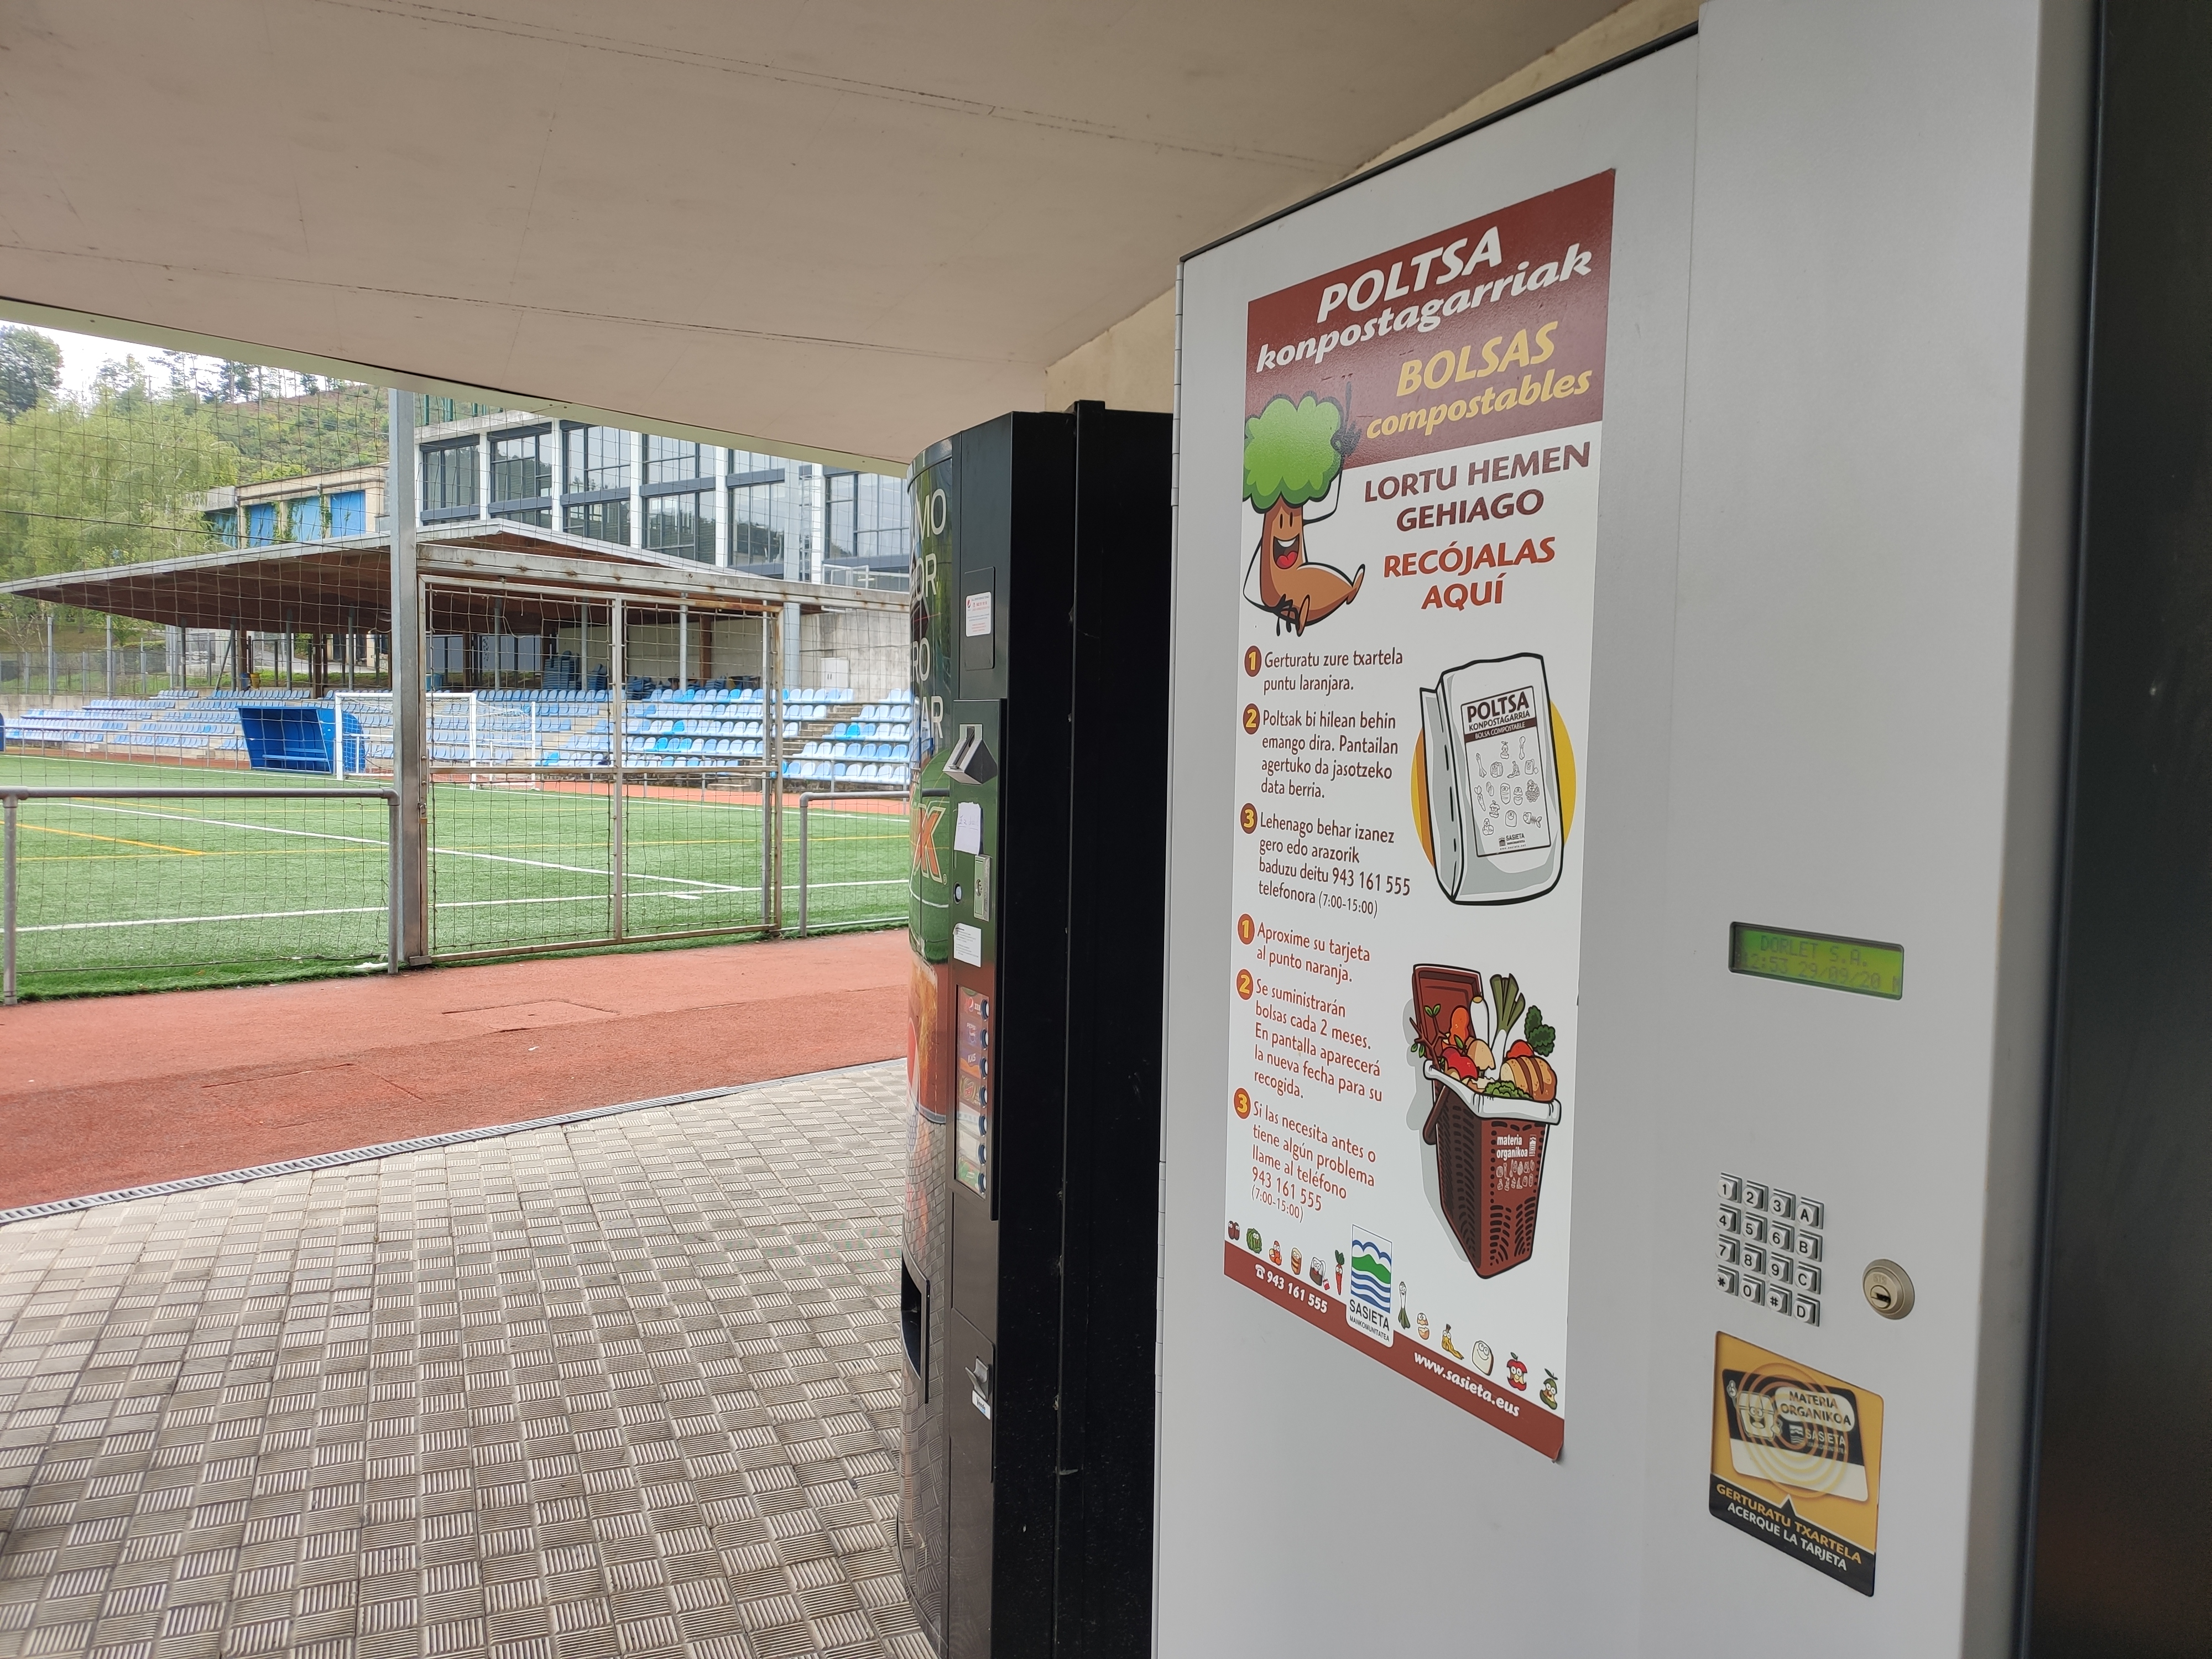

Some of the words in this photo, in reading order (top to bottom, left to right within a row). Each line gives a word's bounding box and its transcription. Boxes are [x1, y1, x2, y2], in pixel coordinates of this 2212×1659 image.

[1317, 226, 1502, 323] POLTSA
[1256, 243, 1592, 373] konpostagarriak
[1396, 321, 1558, 396] BOLSAS
[1366, 370, 1592, 439] compostables
[1364, 465, 1457, 503] LORTU
[1468, 441, 1590, 486] HEMEN
[1396, 489, 1544, 531] GEHIAGO
[1383, 536, 1555, 577] RECÓJALAS
[1421, 573, 1503, 611] AQUÍ
[1248, 651, 1256, 671] 1
[1265, 651, 1319, 668] Gerturatu
[1323, 655, 1349, 667] zure
[1353, 647, 1404, 666] txartela
[1264, 676, 1296, 696] puntu
[1300, 674, 1354, 696] laranjara.
[1245, 708, 1257, 728] 2
[1263, 709, 1302, 726] Poltsak
[1306, 711, 1316, 727] bi
[1319, 711, 1355, 728] hilean
[1360, 711, 1396, 729] behin
[1467, 691, 1529, 723] POLTSA
[1469, 710, 1530, 731] KONPOSTAGARRIA
[1262, 737, 1305, 755] emango
[1309, 734, 1334, 752] dira.
[1339, 735, 1398, 754] Pantailan
[1475, 728, 1490, 739] BOLSA
[1490, 722, 1526, 735] COMPOSTABLE
[1261, 757, 1311, 776] agertuko
[1314, 758, 1328, 774] da
[1331, 759, 1392, 781] jasotzeko
[1261, 777, 1285, 795] data
[1288, 779, 1325, 798] berria.
[1244, 809, 1255, 828] 3
[1260, 812, 1313, 838] Lehenago
[1317, 818, 1351, 838] behar
[1355, 823, 1395, 843] izanez
[1506, 833, 1525, 841] SASIETA
[1260, 839, 1283, 855] gero
[1287, 838, 1308, 856] edo
[1311, 846, 1360, 863] arazorik
[1259, 857, 1297, 877] baduzu
[1300, 863, 1328, 883] deitu
[1332, 867, 1354, 886] 943
[1359, 871, 1381, 891] 161
[1386, 875, 1410, 896] 555
[1259, 880, 1316, 904] telefonora
[1318, 891, 1378, 919] (7:00-15:00)
[1241, 920, 1249, 938] 1
[1257, 922, 1310, 948] Aproxime
[1313, 939, 1326, 951] su
[1329, 939, 1370, 963] tarjeta
[1761, 935, 1818, 959] DORLET
[1829, 946, 1867, 967] S.A.
[1256, 945, 1265, 960] al
[1269, 952, 1302, 969] punto
[1306, 959, 1352, 984] naranja.
[1239, 974, 1250, 994] 2
[1256, 978, 1268, 995] Se
[1271, 988, 1345, 1018] suministrarán
[1256, 1000, 1287, 1023] bolsas
[1290, 1015, 1316, 1032] cada
[1320, 1019, 1328, 1036] 2
[1332, 1028, 1371, 1050] meses.
[967, 1053, 976, 1063] KAS
[1255, 1022, 1269, 1040] En
[1272, 1032, 1316, 1056] pantalla
[1320, 1047, 1380, 1077] aparecerá
[1254, 1071, 1303, 1099] recogida.
[1255, 1044, 1264, 1061] la
[1267, 1053, 1299, 1073] nueva
[1303, 1061, 1334, 1085] fecha
[1338, 1078, 1365, 1095] para
[1369, 1088, 1382, 1102] su
[1237, 1094, 1248, 1113] 3
[1254, 1101, 1262, 1118] Si
[1265, 1105, 1279, 1124] las
[1282, 1117, 1328, 1144] necesita
[1332, 1135, 1364, 1159] antes
[1368, 1151, 1376, 1162] o
[1496, 1134, 1522, 1146] materia
[1253, 1124, 1280, 1147] tiene
[1283, 1137, 1313, 1162] algún
[1317, 1154, 1375, 1187] problema
[1253, 1144, 1281, 1171] llame
[1284, 1160, 1293, 1176] al
[1297, 1166, 1347, 1199] teléfono
[1496, 1146, 1528, 1161] organikoa
[1251, 1184, 1303, 1223] (7:00-15:00)
[1252, 1166, 1271, 1188] 943
[1276, 1177, 1295, 1200] 161
[1300, 1188, 1322, 1211] 555
[1722, 1183, 1727, 1196] 1
[1746, 1191, 1754, 1204] 2
[1773, 1199, 1781, 1212] 3
[1801, 1208, 1809, 1222] A
[1719, 1215, 1727, 1227] 4
[1745, 1223, 1754, 1235] 5
[1772, 1232, 1781, 1245] 6
[1799, 1240, 1808, 1254] B
[1719, 1244, 1726, 1256] 7
[1744, 1254, 1752, 1267] 8
[1771, 1263, 1779, 1276] 9
[1798, 1272, 1807, 1287] C
[1266, 1271, 1285, 1290] 943
[1287, 1282, 1305, 1302] 161
[1308, 1294, 1328, 1314] 555
[1797, 1305, 1806, 1318] D
[1349, 1299, 1390, 1331] SASIETA
[1349, 1315, 1390, 1343] MANKOMUNITATEA
[1414, 1352, 1521, 1417] www.sasieta.eus
[1790, 1391, 1838, 1410] MATERIA
[1780, 1403, 1851, 1426] ORGANIKOA
[1805, 1428, 1846, 1446] SASIETA
[1717, 1483, 1791, 1527] GERTURATU
[1794, 1521, 1862, 1564] TXARTELA
[1727, 1501, 1780, 1536] ACERQUE
[1783, 1530, 1798, 1545] LA
[1801, 1538, 1848, 1571] TARJETA
